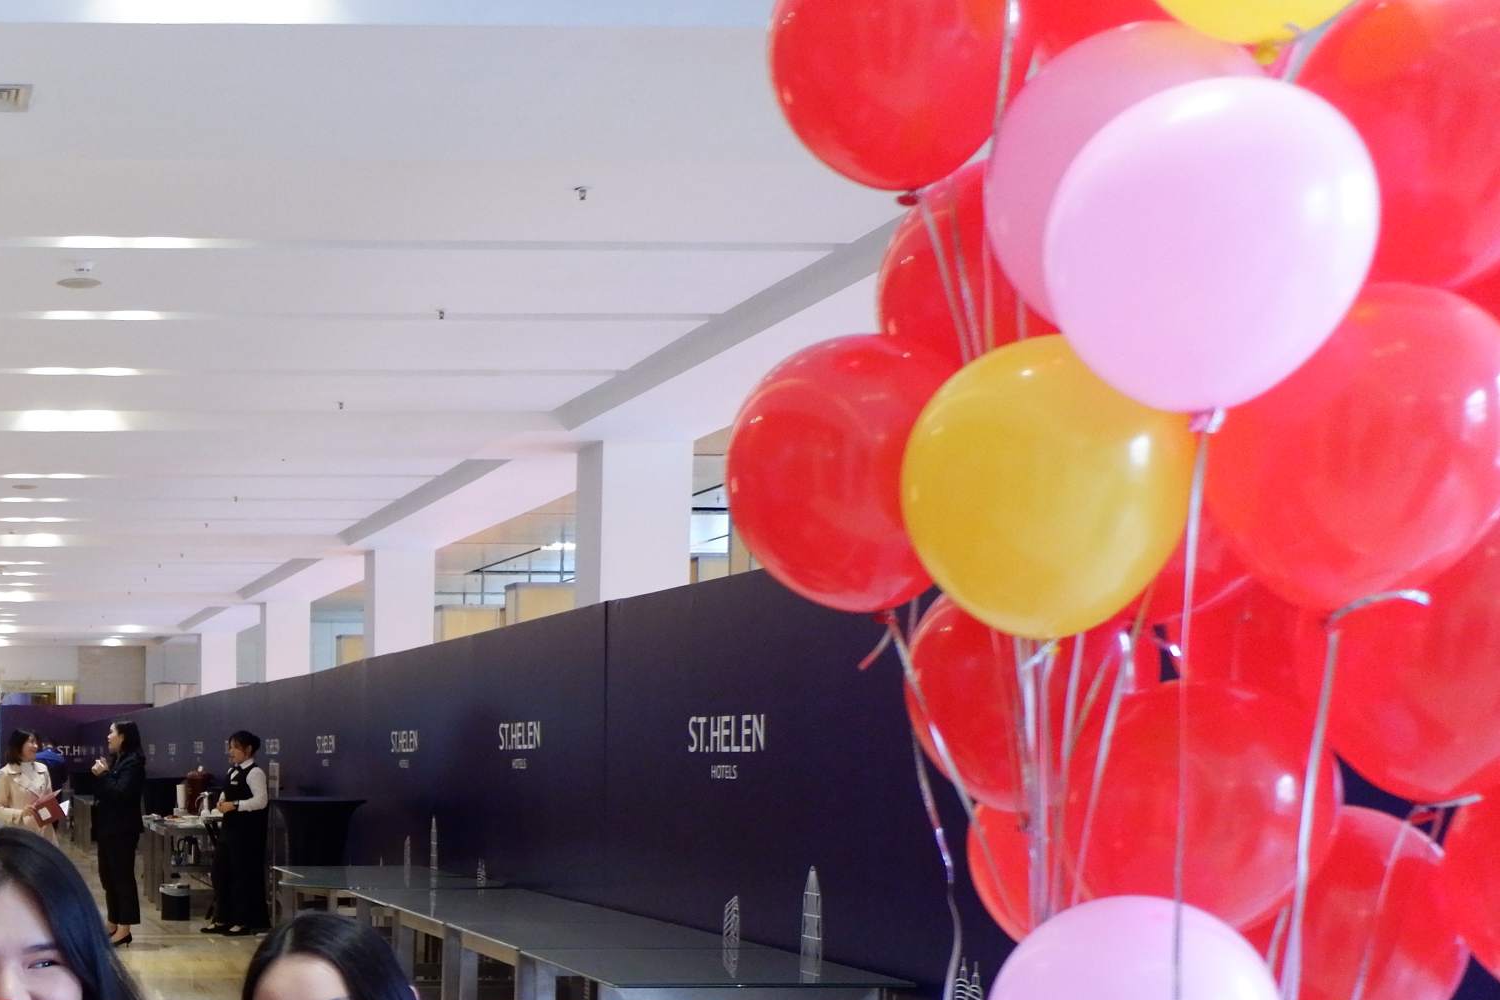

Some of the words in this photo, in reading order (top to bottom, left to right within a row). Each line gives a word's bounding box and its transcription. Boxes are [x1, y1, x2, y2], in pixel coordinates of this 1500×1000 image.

[390, 730, 419, 753] ST.HELEN
[499, 721, 541, 750] ST.HELEN
[688, 714, 765, 753] ST.HELEN
[711, 765, 737, 780] HOTELS
